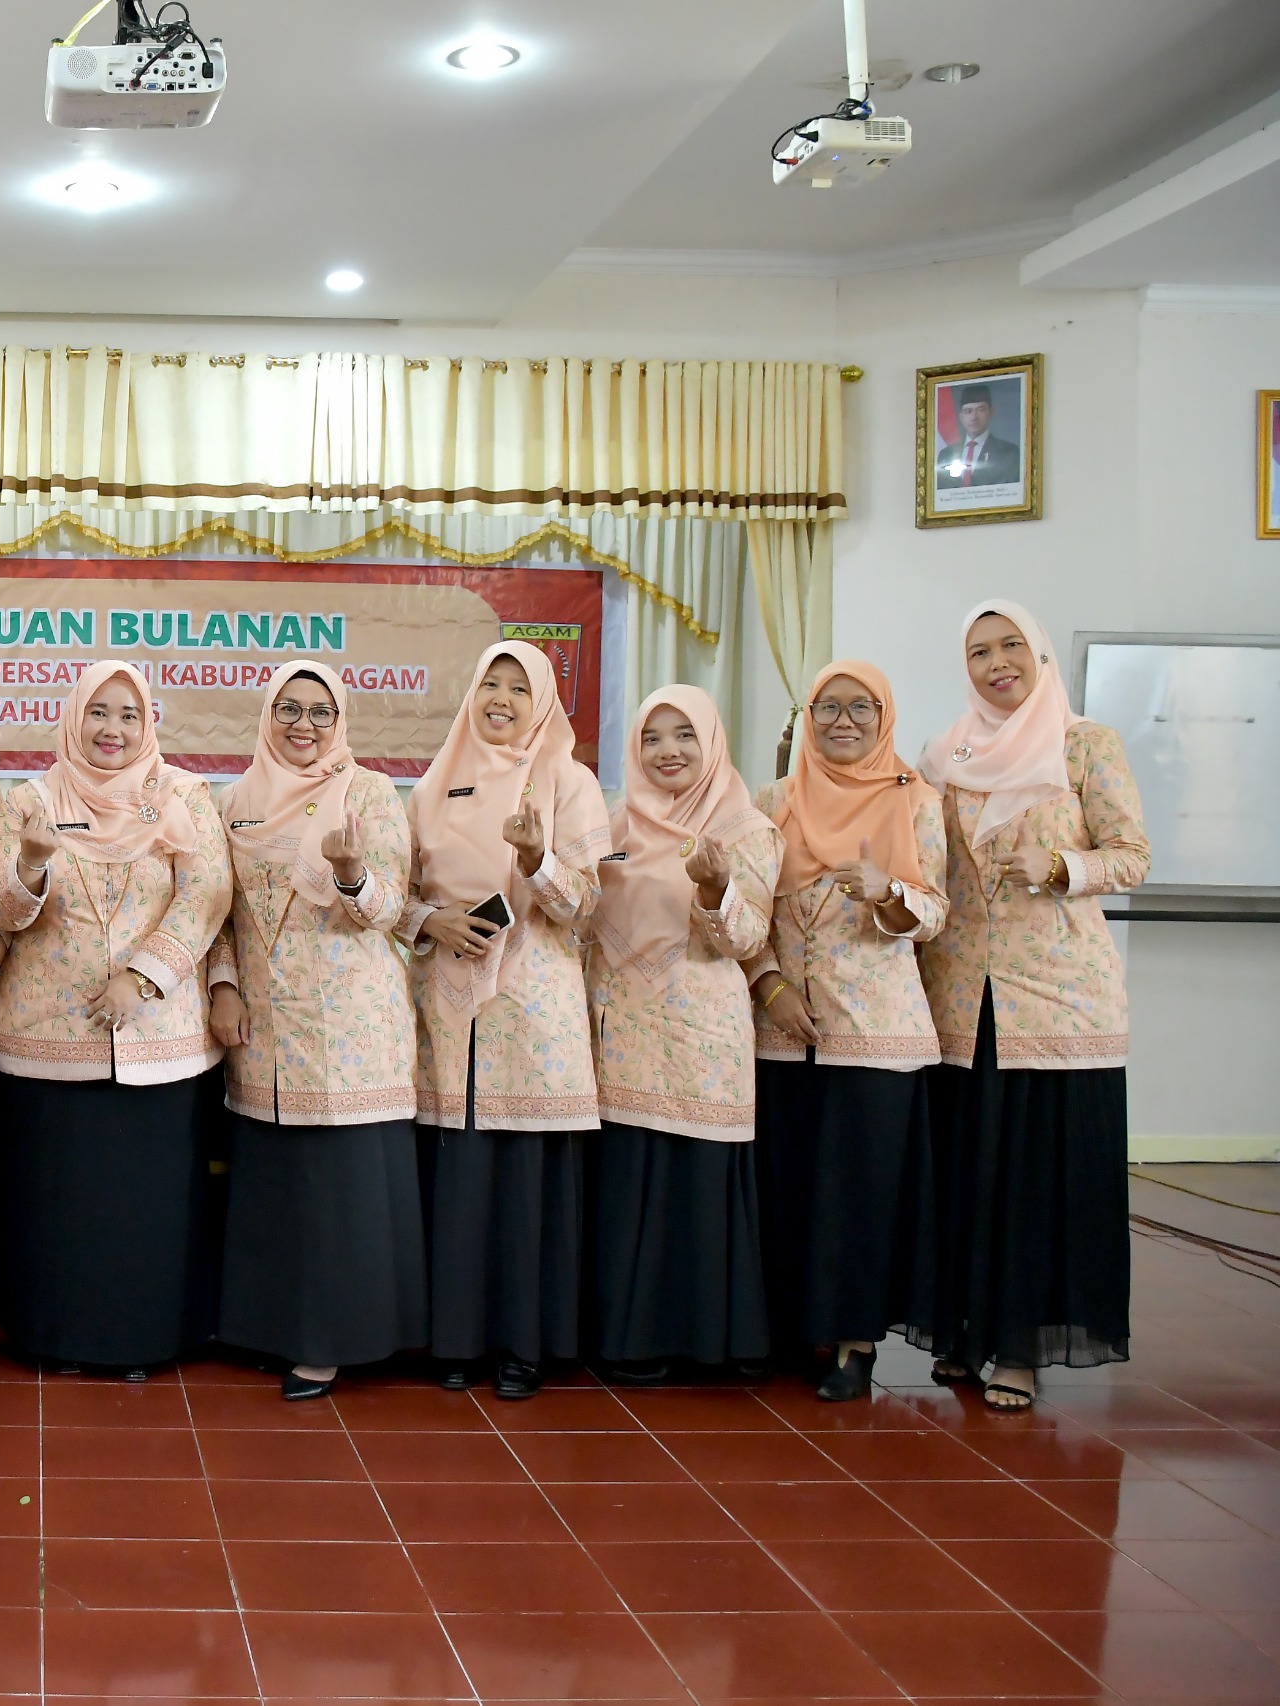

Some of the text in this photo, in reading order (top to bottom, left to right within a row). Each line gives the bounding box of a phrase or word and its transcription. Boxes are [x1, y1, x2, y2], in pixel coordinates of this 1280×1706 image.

[111, 612, 343, 649] BULANAN
[512, 626, 571, 637] AGAM
[161, 664, 279, 687] KABUPA
[341, 667, 425, 690] AGAM
